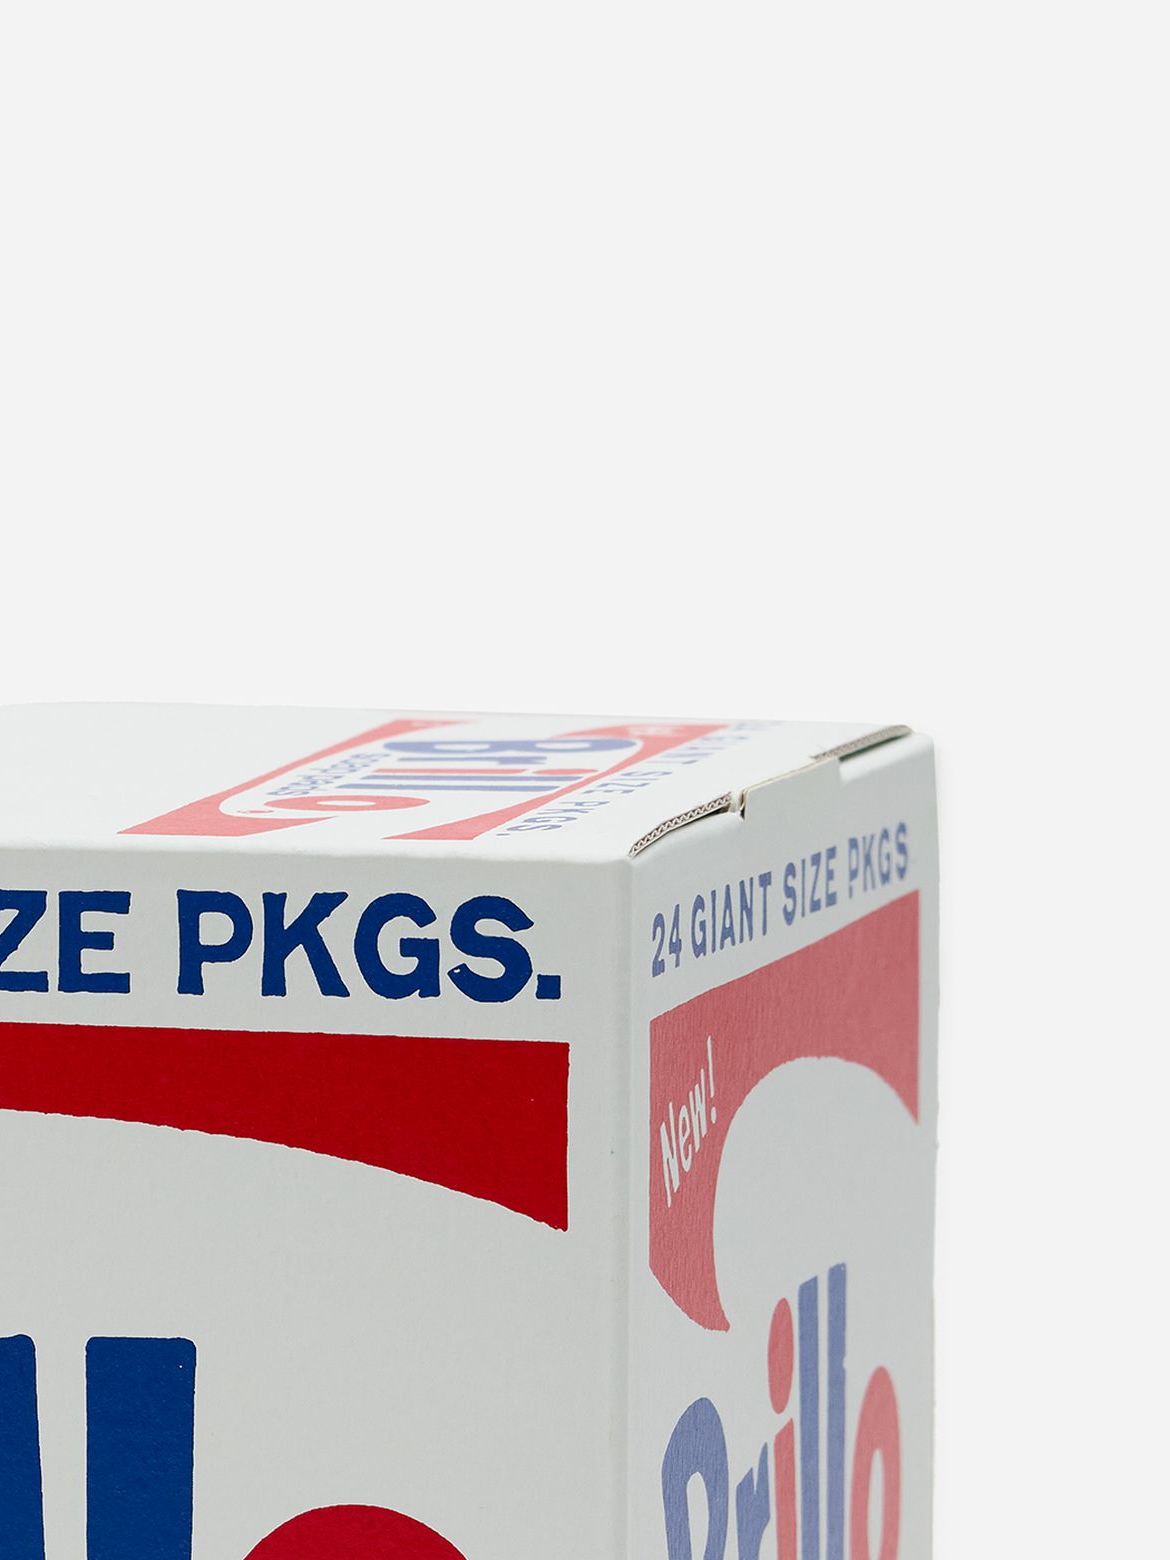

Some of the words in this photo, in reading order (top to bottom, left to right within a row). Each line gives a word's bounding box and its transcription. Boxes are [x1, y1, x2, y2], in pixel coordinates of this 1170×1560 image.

[263, 738, 638, 811] Brillo
[175, 888, 563, 1003] PKGS.
[652, 903, 683, 978] 24
[690, 870, 772, 959] GIANT
[782, 845, 837, 927] SIZE
[848, 821, 909, 899] PKGS
[659, 1035, 718, 1208] New!
